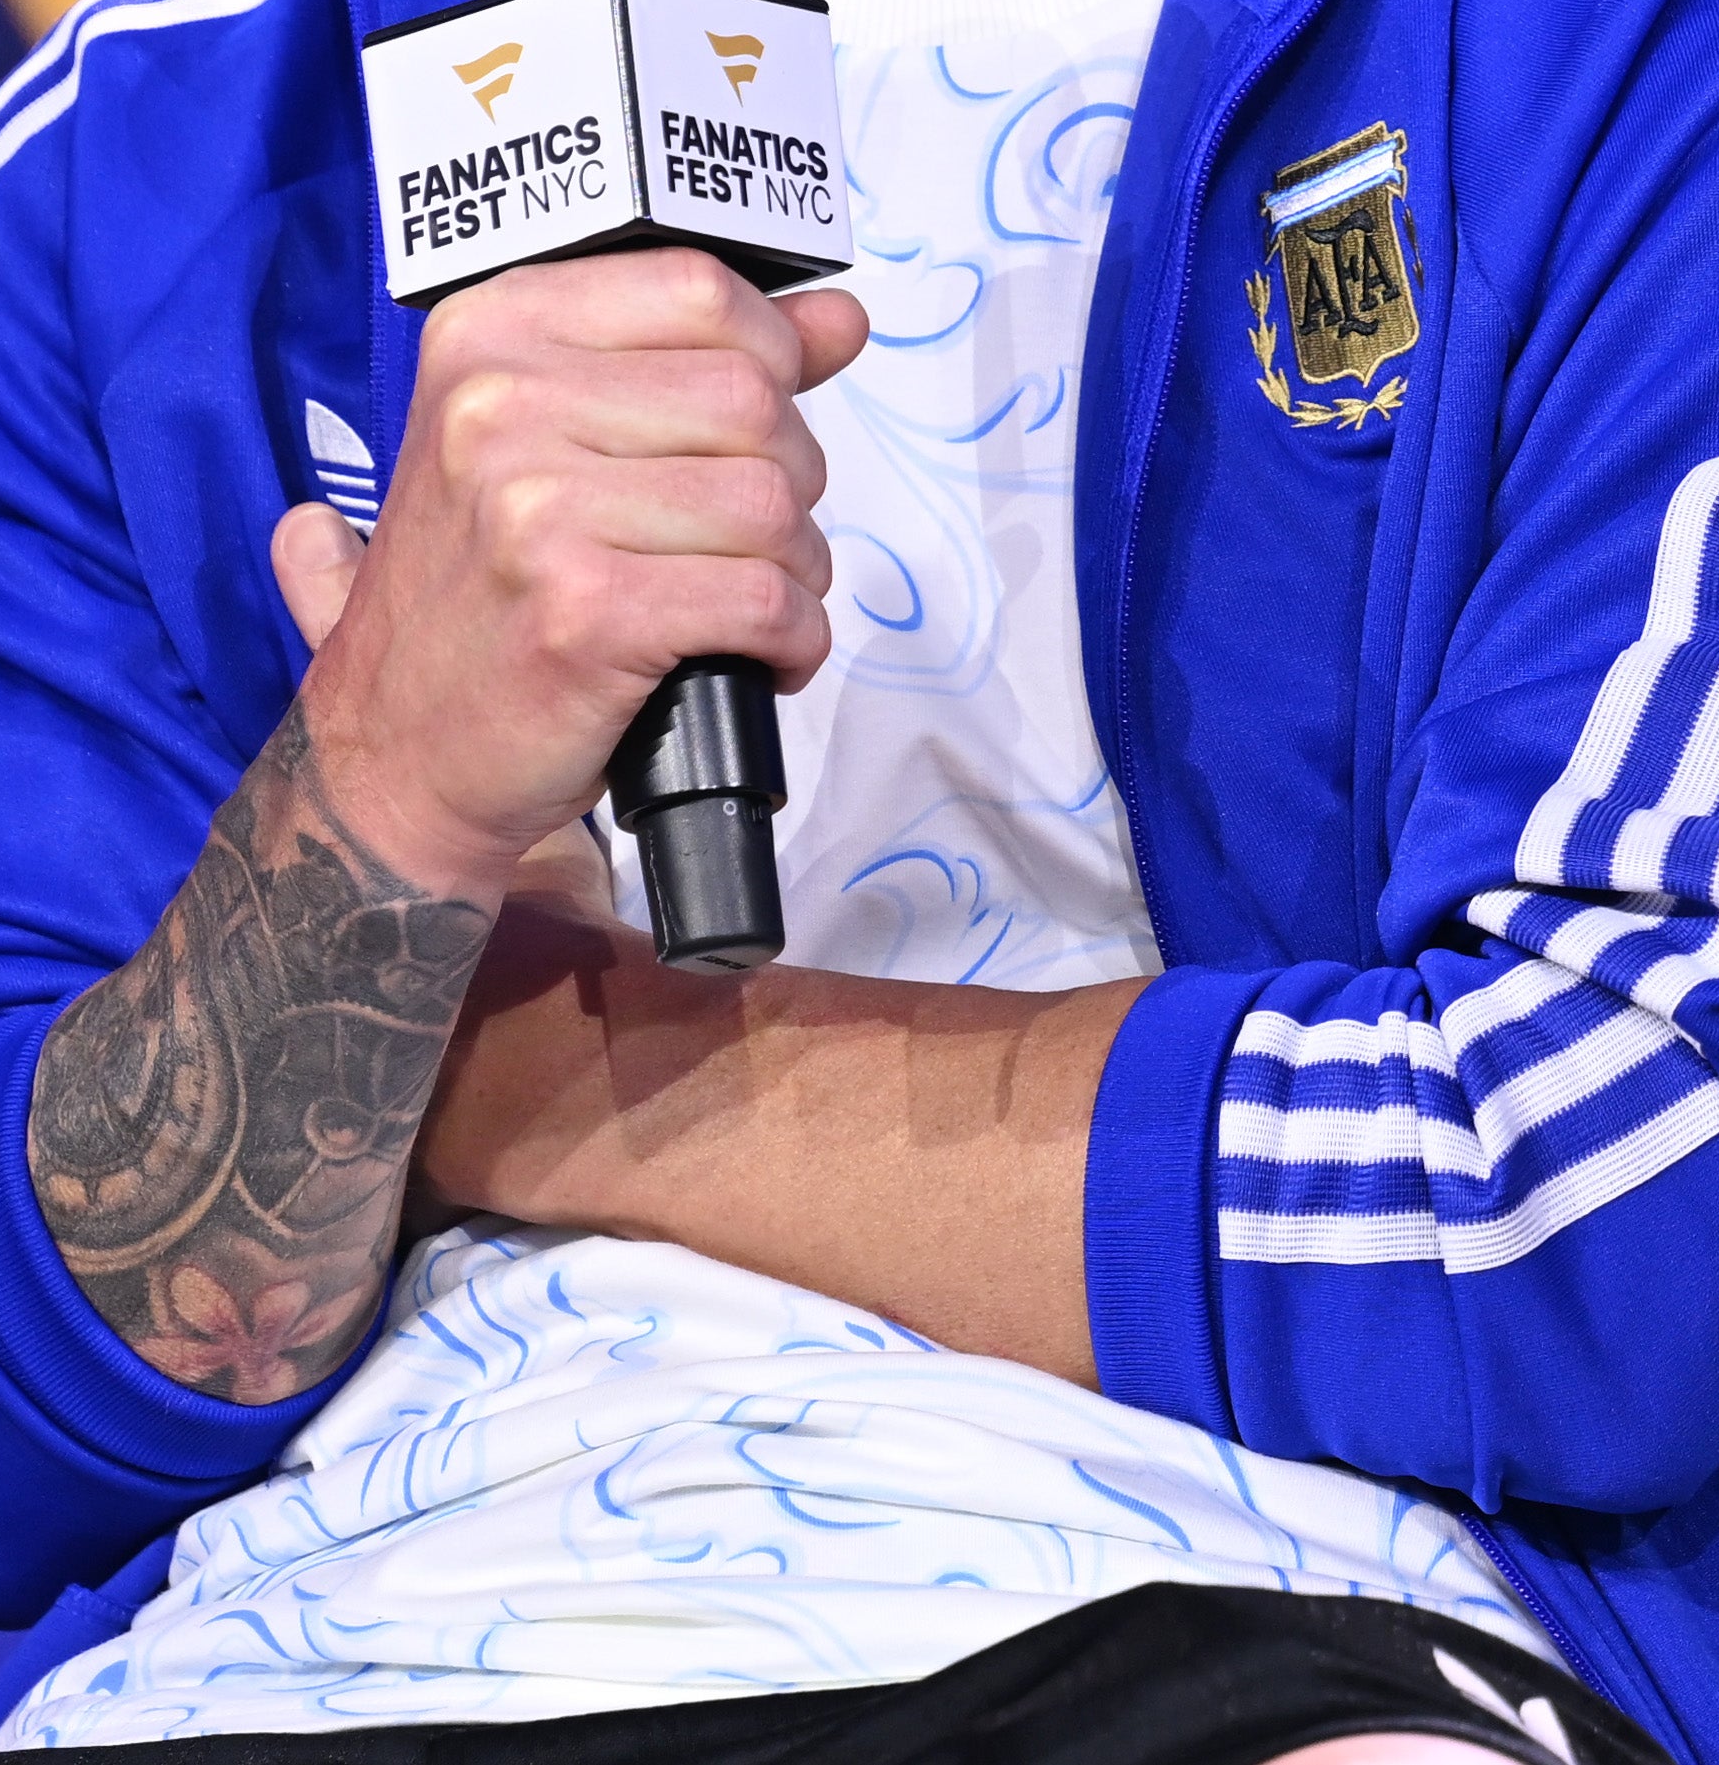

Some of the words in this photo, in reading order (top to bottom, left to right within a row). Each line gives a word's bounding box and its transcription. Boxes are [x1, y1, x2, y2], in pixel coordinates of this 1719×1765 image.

[398, 115, 601, 214] FANATICS
[660, 110, 829, 181] FANATICS
[666, 153, 753, 208] FEST
[764, 174, 834, 225] NYC
[402, 187, 507, 258] FEST
[521, 159, 606, 220] NYC
[1299, 208, 1402, 338] AFA
